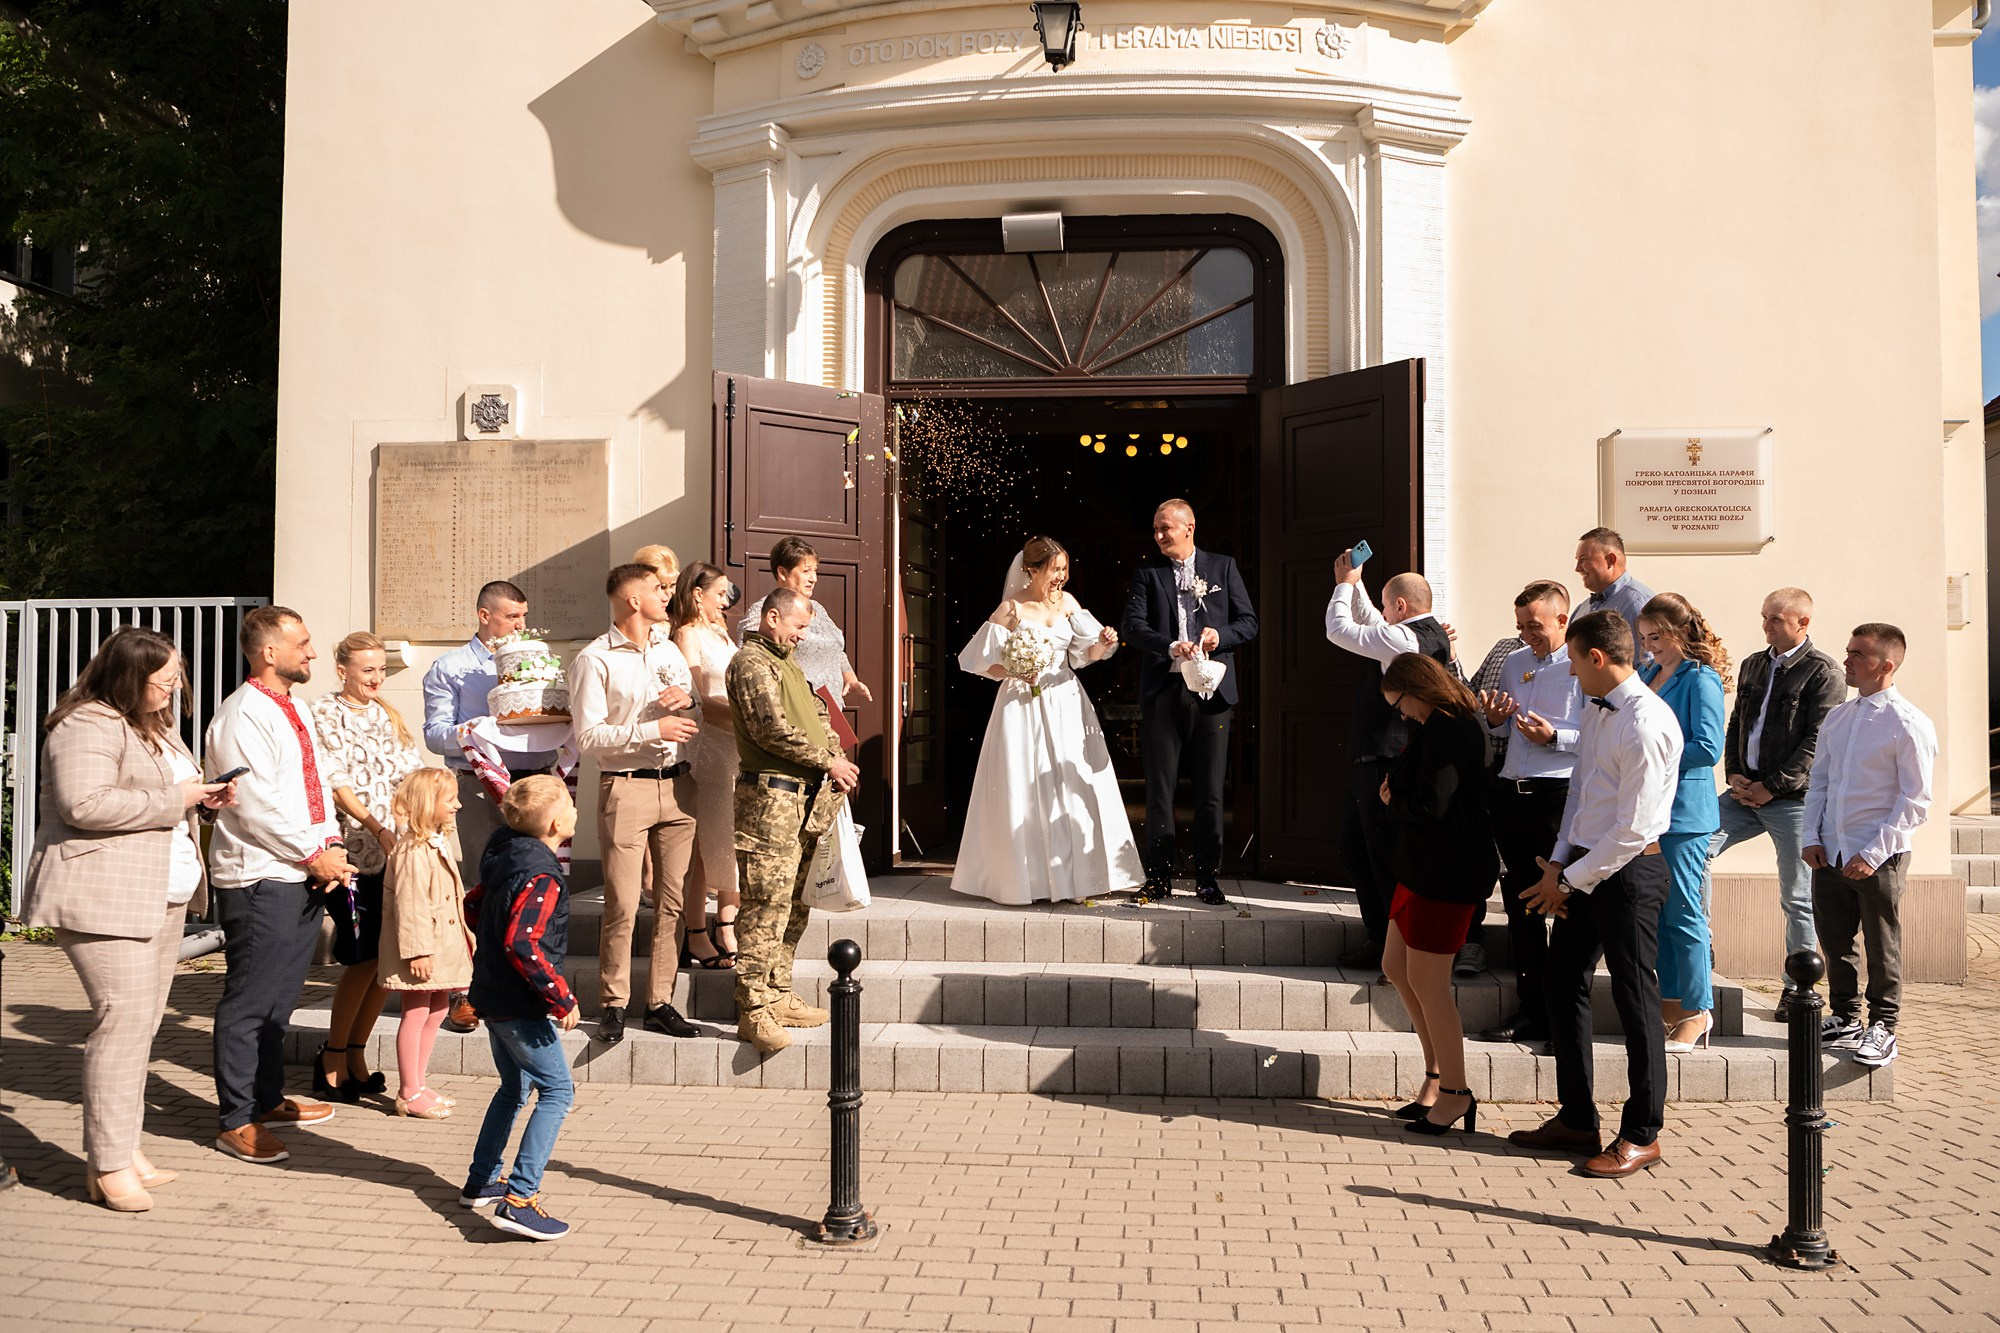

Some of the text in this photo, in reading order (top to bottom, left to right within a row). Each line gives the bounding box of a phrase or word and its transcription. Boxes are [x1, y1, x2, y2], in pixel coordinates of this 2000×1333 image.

[849, 41, 896, 66] OTO
[902, 34, 953, 60] DOM
[1115, 24, 1201, 50] BRAMA
[1208, 24, 1299, 53] NIEBIOS
[1713, 479, 1765, 487] БОГОРОДИЦІ
